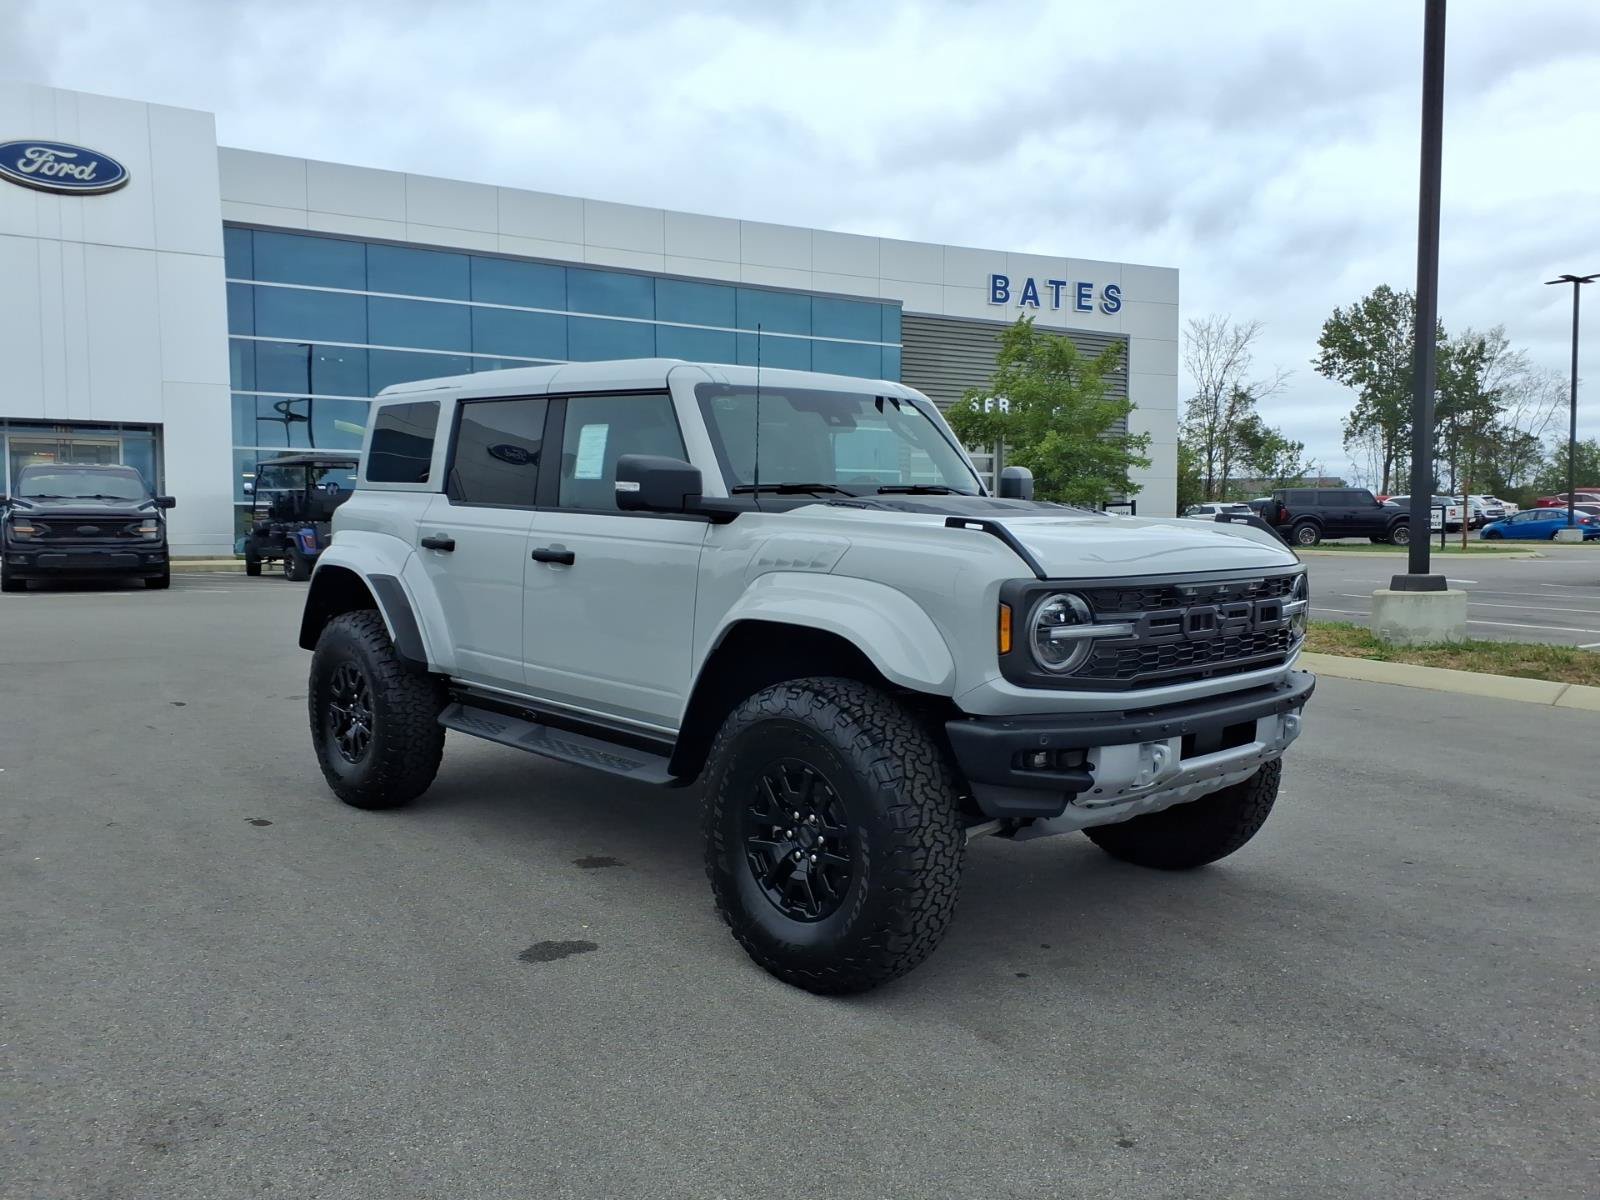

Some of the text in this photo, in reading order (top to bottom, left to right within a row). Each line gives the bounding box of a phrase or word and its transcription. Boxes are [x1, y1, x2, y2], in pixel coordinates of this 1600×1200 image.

[17, 147, 96, 180] Ford
[988, 274, 1122, 314] BATES
[1139, 599, 1283, 646] FORD
